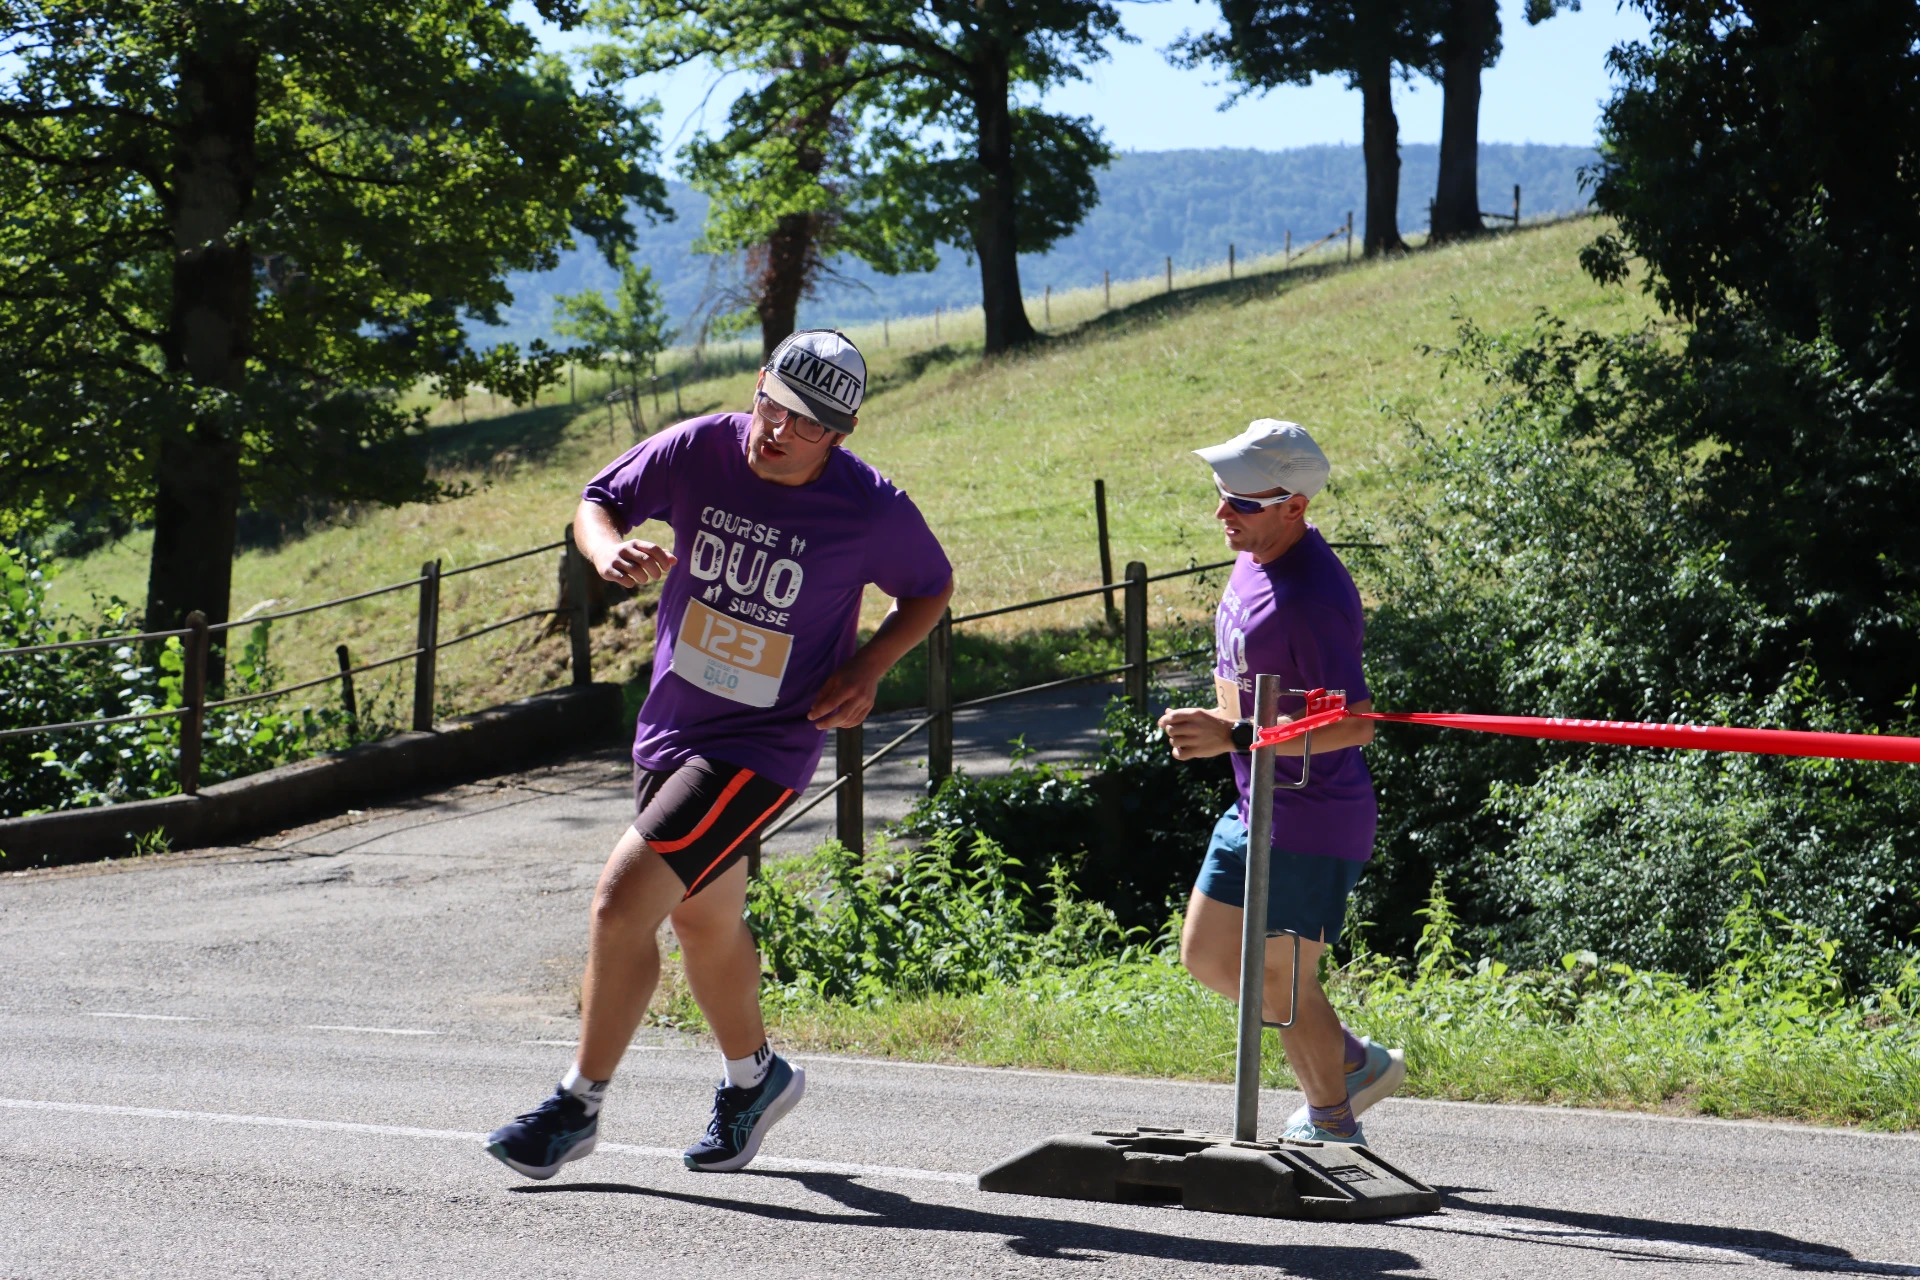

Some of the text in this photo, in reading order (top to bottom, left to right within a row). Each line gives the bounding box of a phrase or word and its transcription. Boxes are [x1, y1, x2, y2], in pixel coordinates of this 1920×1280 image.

[780, 348, 861, 406] DYNAFIT
[701, 506, 781, 548] COURSE
[690, 529, 804, 609] DUO
[728, 597, 790, 627] SUISSE
[699, 613, 766, 667] 123
[703, 664, 739, 689] DUO
